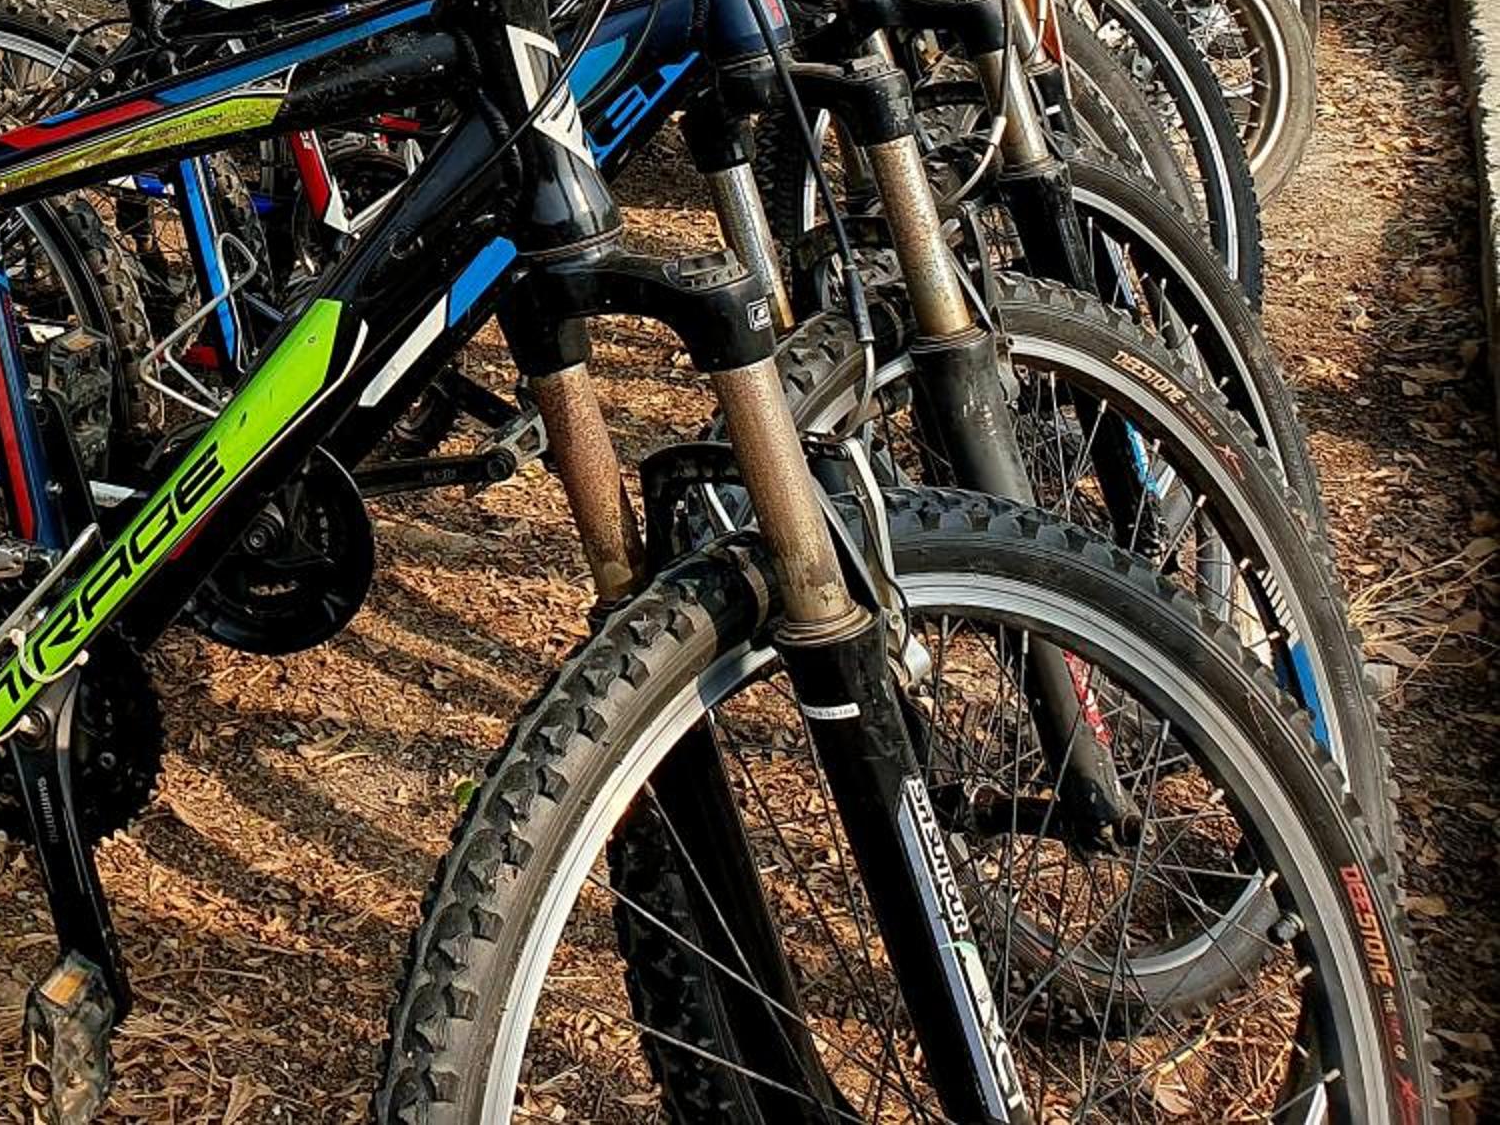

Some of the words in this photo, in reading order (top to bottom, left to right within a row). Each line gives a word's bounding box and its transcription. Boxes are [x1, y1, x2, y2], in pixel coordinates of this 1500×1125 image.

[1111, 350, 1186, 404] DEESTONE
[925, 824, 969, 934] SUNTOUR
[1340, 863, 1395, 987] DEESTONE
